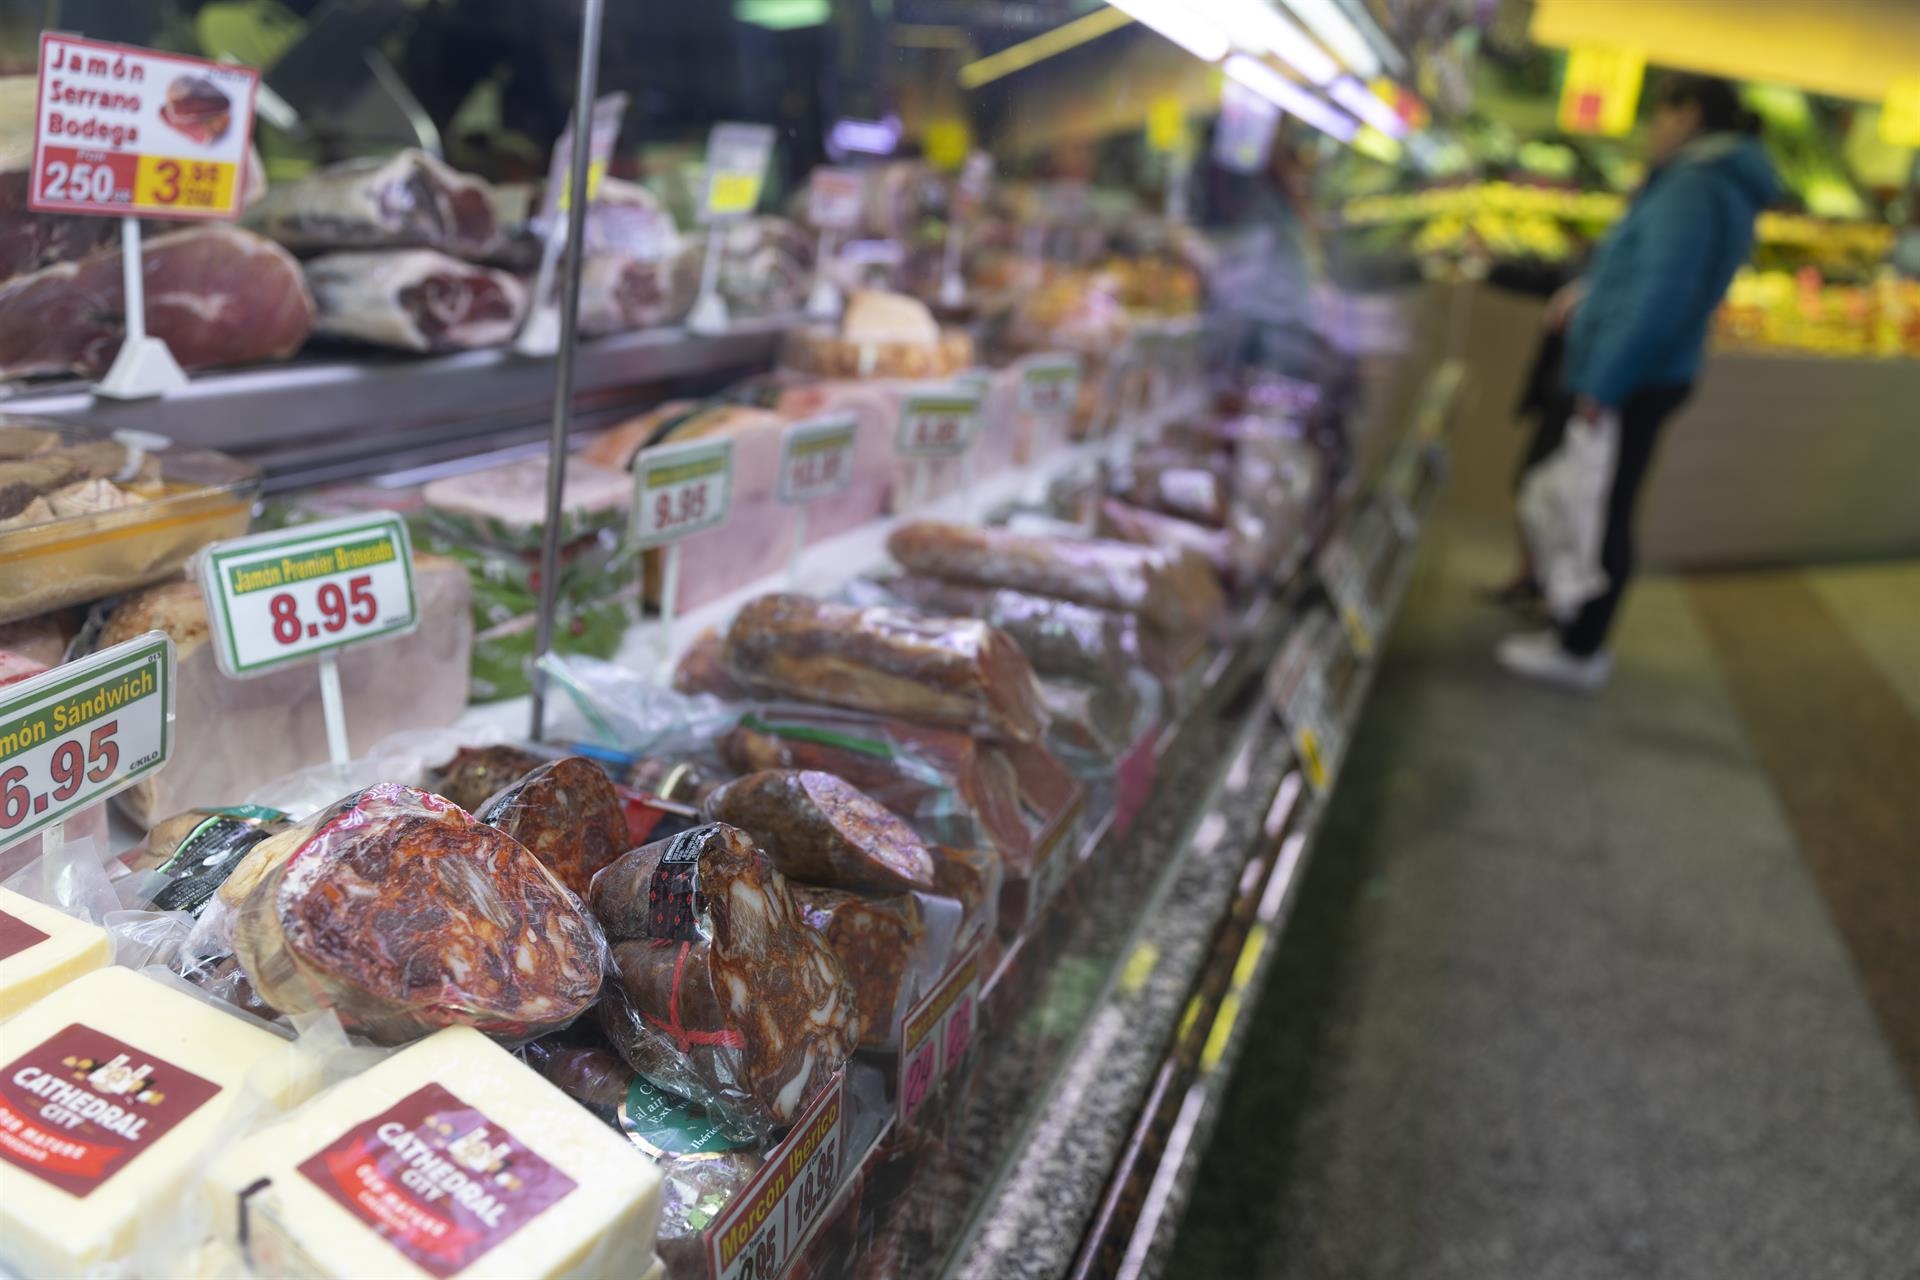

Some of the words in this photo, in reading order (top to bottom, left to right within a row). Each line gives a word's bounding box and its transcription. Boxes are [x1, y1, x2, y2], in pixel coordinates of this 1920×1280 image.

[51, 46, 144, 82] Jamón
[50, 81, 141, 112] Serrano
[48, 112, 138, 148] Bodega
[44, 160, 115, 204] 250
[234, 563, 281, 593] Jamón
[269, 574, 378, 645] 8.95
[0, 720, 46, 758] món
[53, 669, 153, 732] Sándwich
[0, 720, 120, 830] 6.95
[12, 1066, 148, 1140] CATHEDRAL
[40, 1102, 85, 1129] CITY
[635, 1106, 648, 1120] al
[647, 1096, 663, 1113] air
[376, 1121, 507, 1228] CATHEDRAL
[400, 1167, 445, 1203] CITY
[722, 1174, 785, 1265] Morcón
[788, 1102, 837, 1178] Ibérico
[795, 1137, 836, 1233] 19.95
